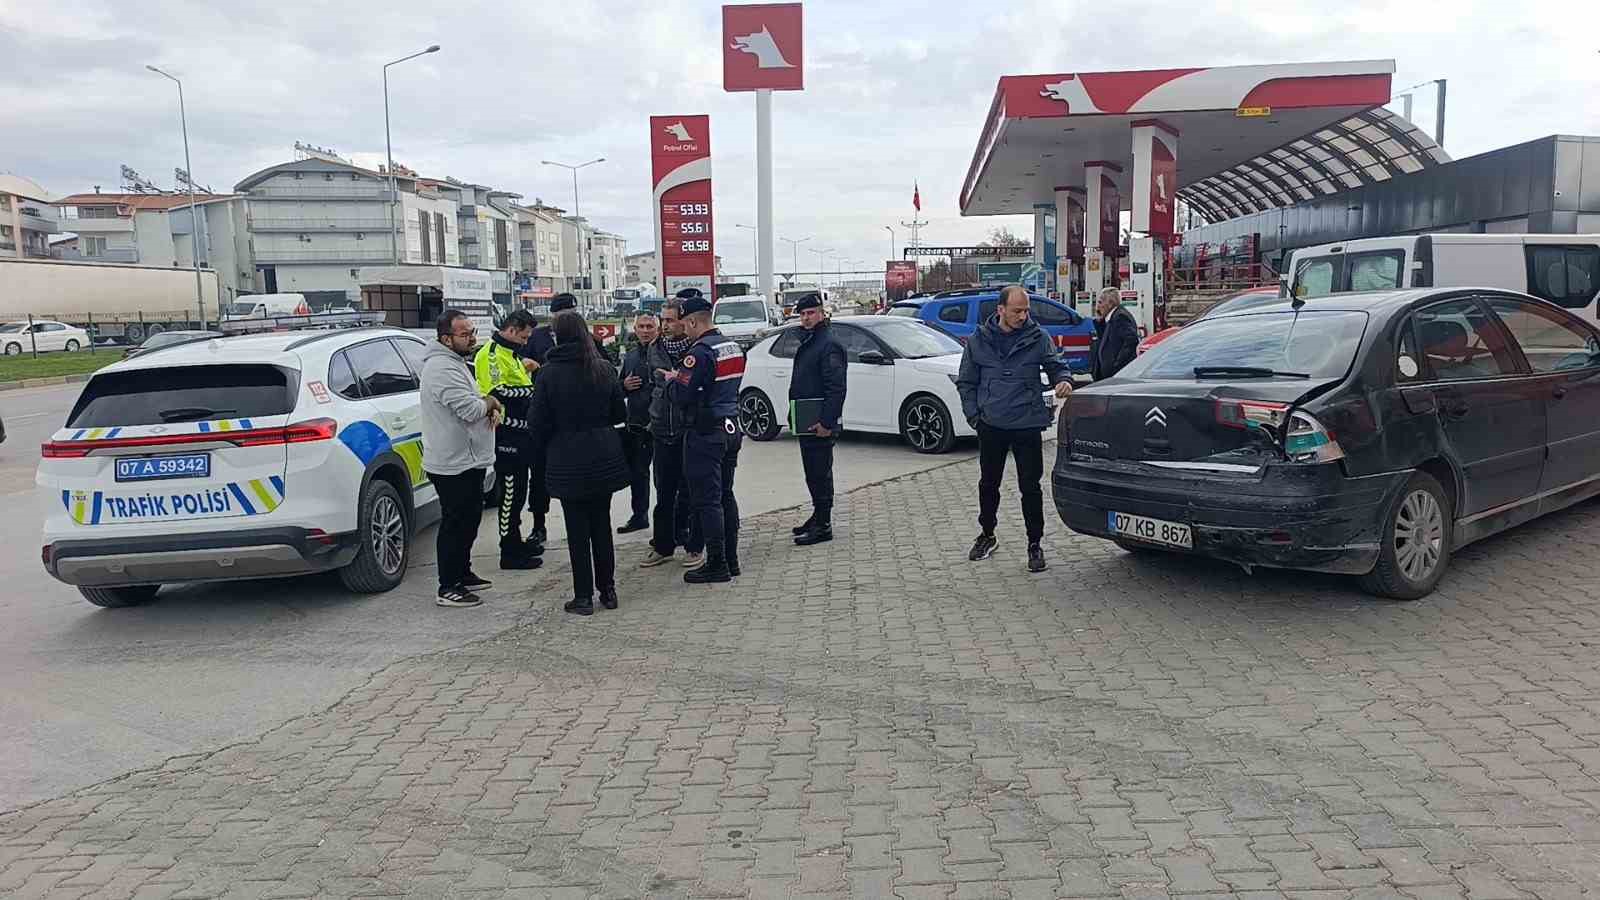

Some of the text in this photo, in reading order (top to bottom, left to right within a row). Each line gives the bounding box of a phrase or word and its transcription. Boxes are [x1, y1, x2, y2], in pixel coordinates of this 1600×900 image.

[680, 204, 708, 215] 53.93
[681, 223, 709, 233] 55.61
[681, 240, 710, 251] 28.58
[310, 382, 325, 395] 112
[120, 458, 204, 475] 07 A 59342
[105, 488, 231, 518] TRAFİK POLİSİ
[1116, 515, 1187, 543] 07 KB 867
